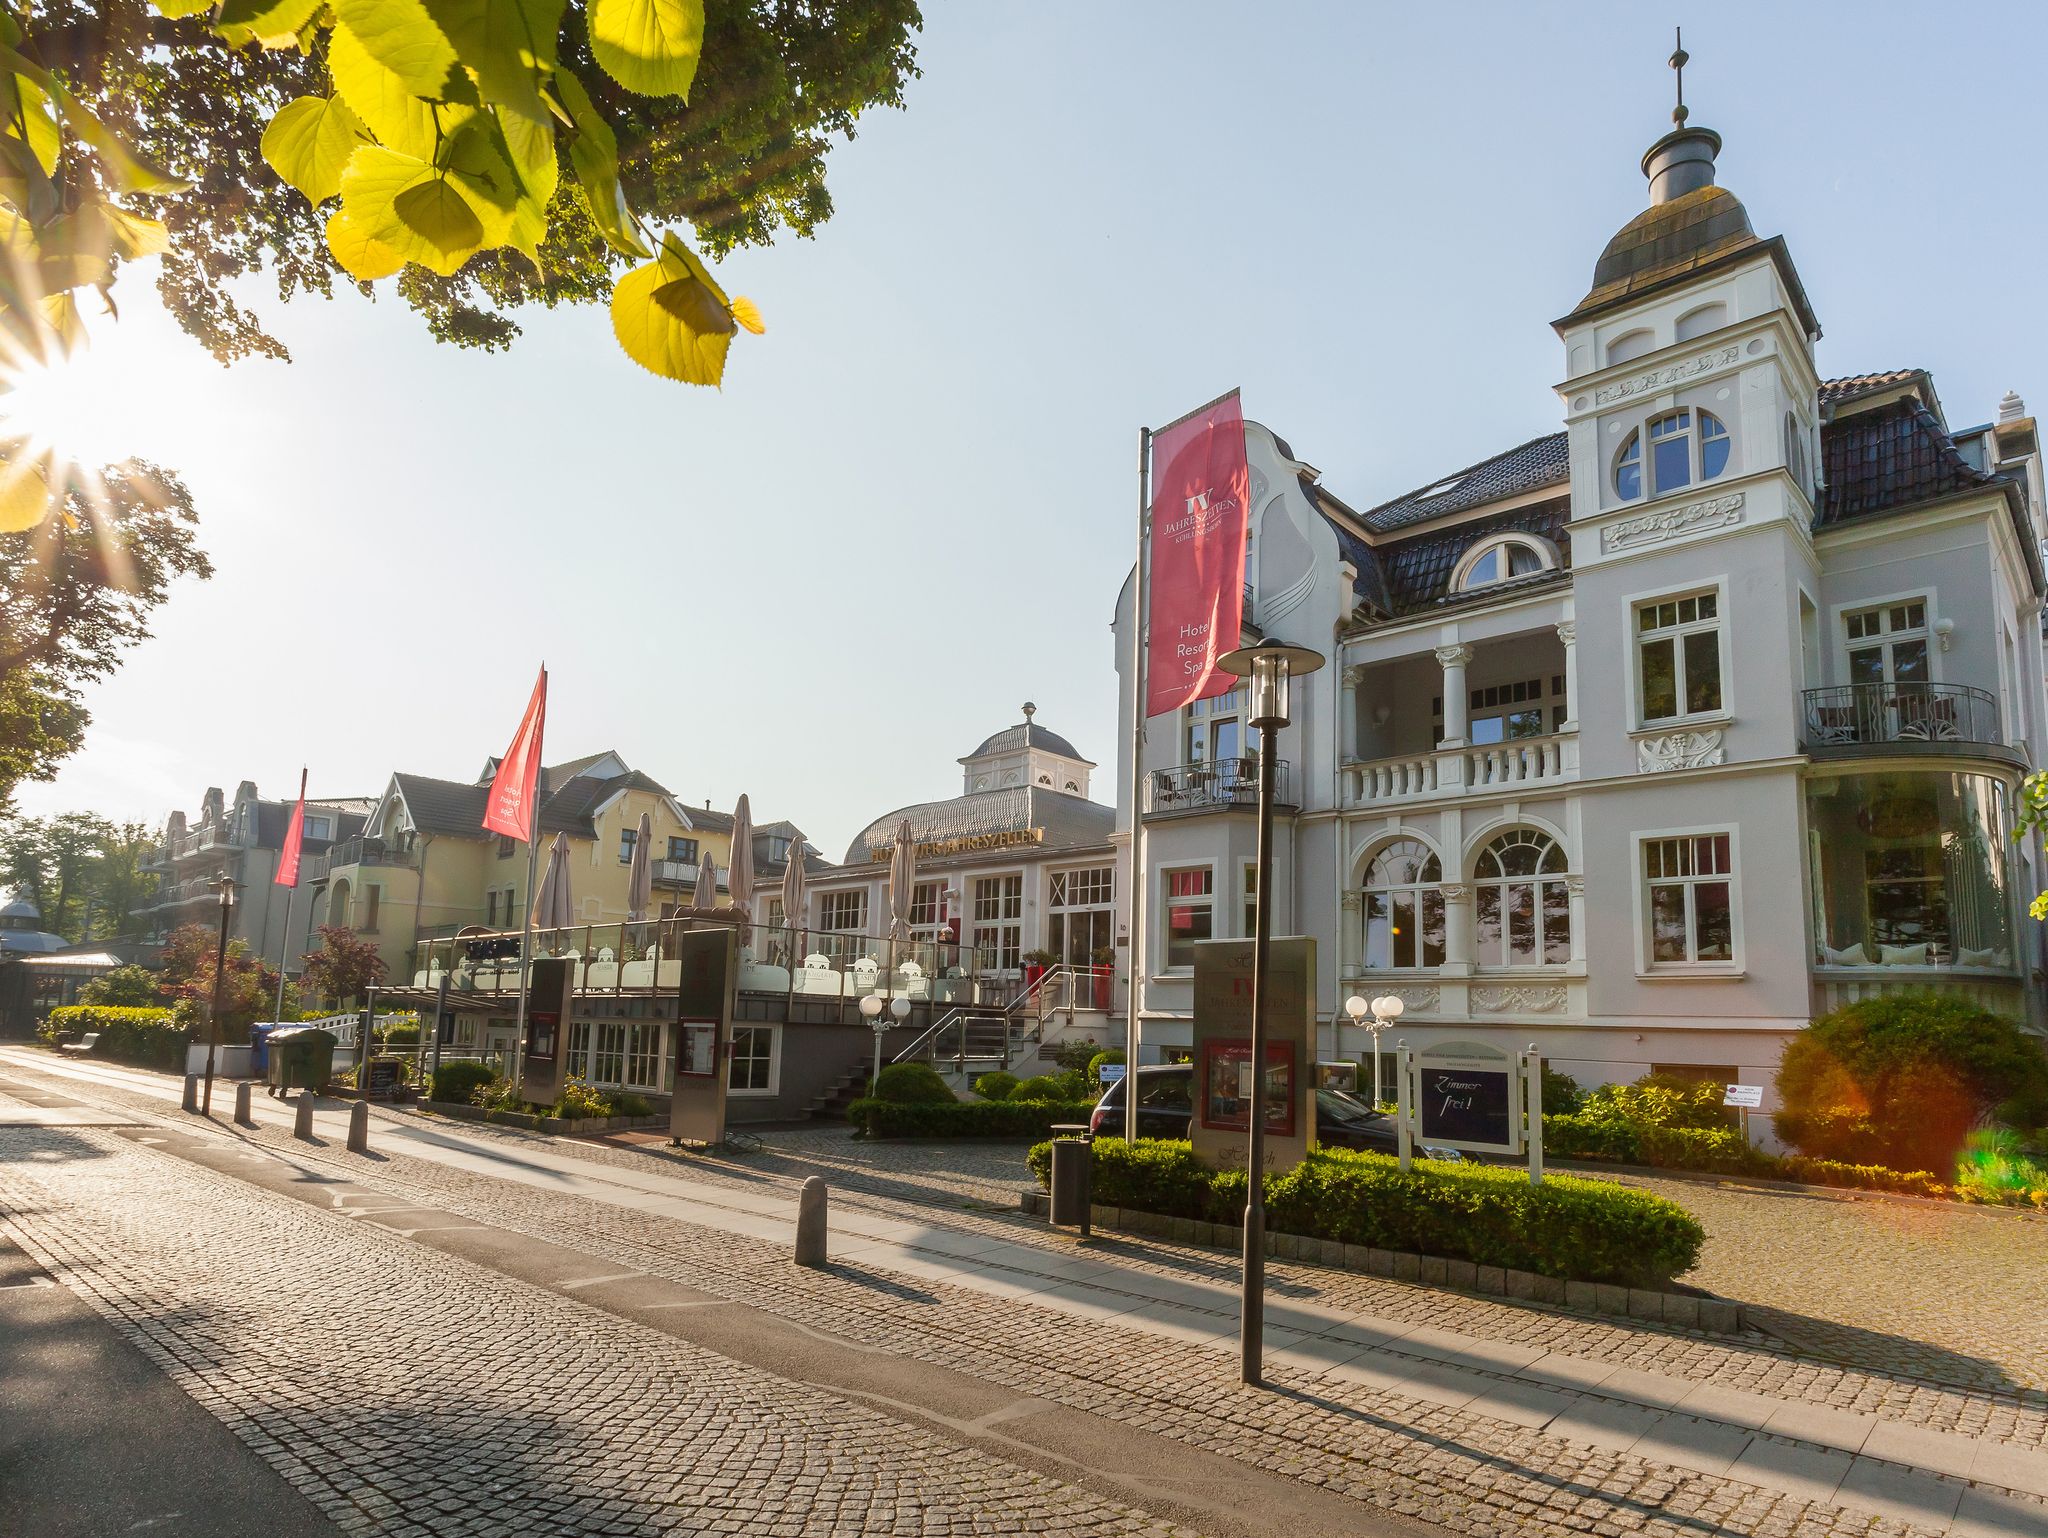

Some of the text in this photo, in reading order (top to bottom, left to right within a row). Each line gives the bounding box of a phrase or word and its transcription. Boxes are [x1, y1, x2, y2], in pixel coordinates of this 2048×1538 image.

[1185, 488, 1214, 515] IV
[1164, 499, 1237, 535] JAHRESZEITEN
[1180, 617, 1210, 638] Hotel
[1177, 638, 1209, 658] Resort
[1184, 660, 1203, 678] Spa
[1434, 1075, 1482, 1094] Zimmer
